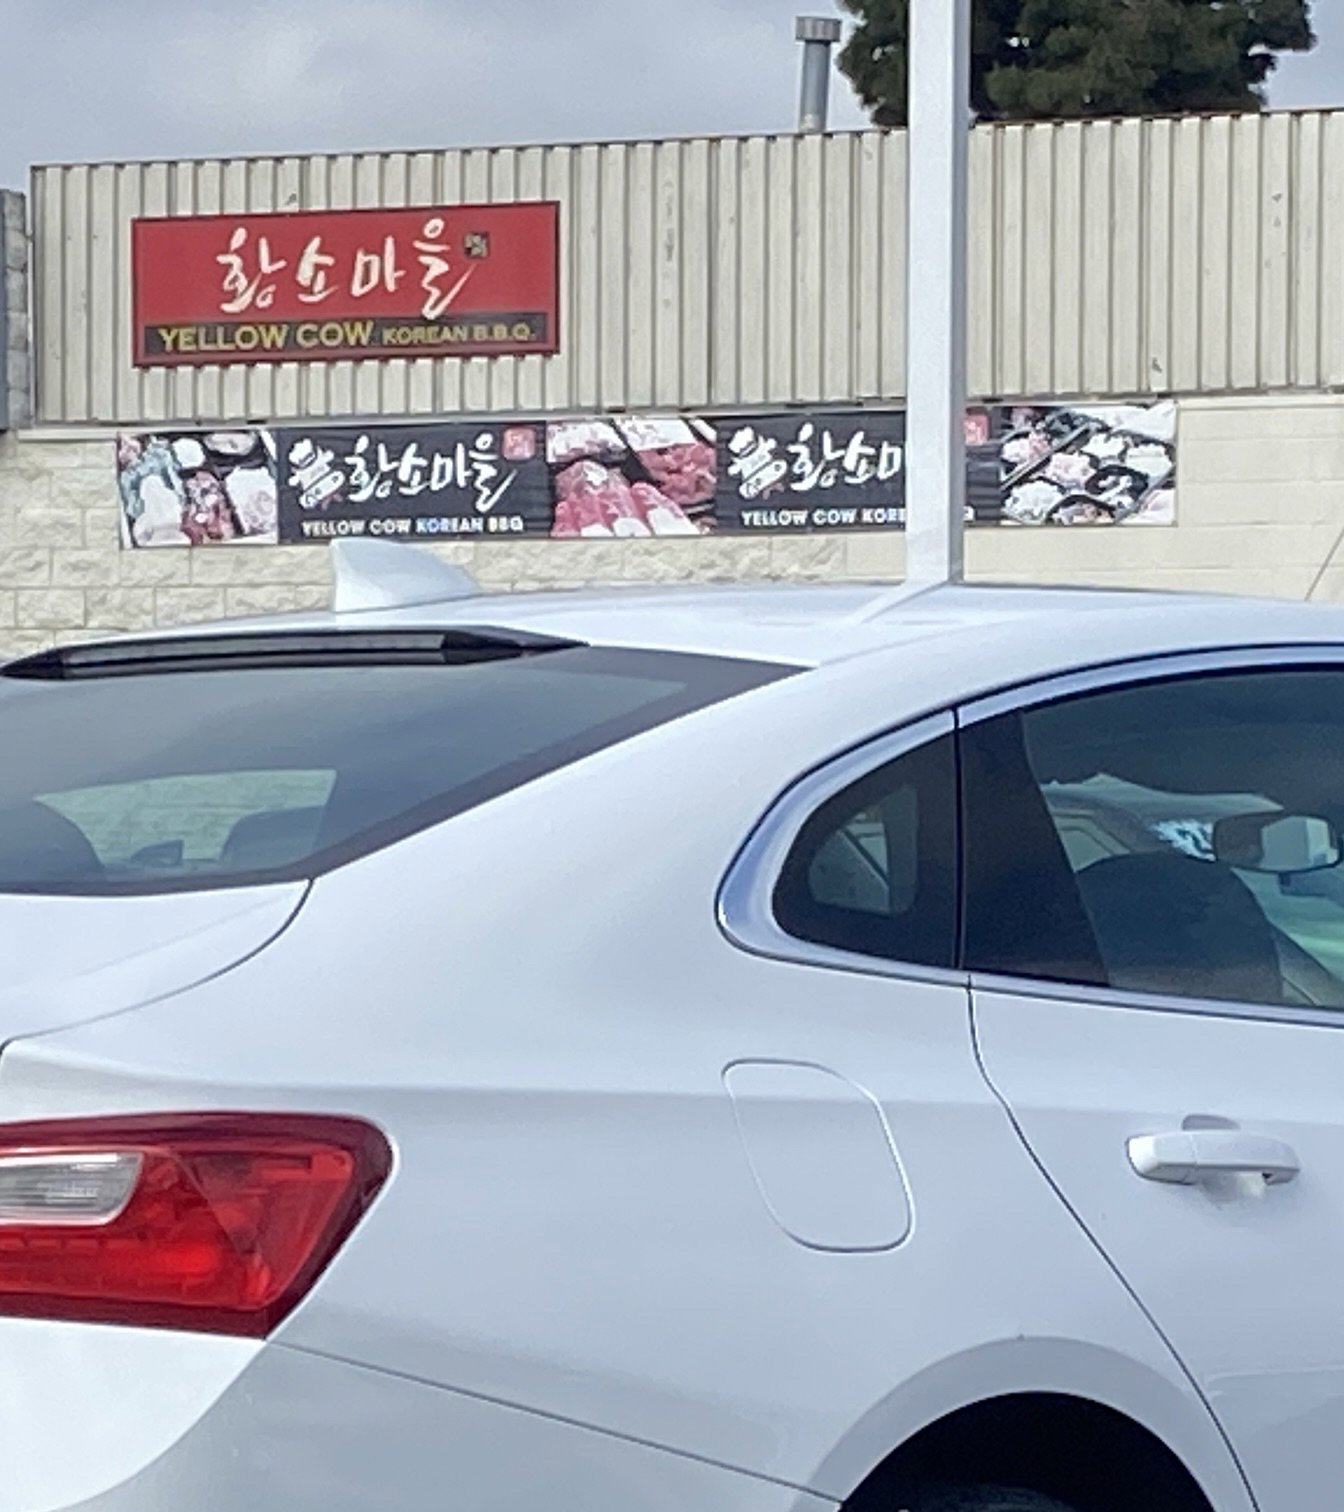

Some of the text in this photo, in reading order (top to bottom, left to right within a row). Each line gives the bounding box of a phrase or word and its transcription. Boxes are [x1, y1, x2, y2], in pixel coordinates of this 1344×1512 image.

[158, 324, 289, 351] YELLOW
[296, 321, 374, 348] COW
[382, 325, 468, 345] KOREAN
[741, 508, 907, 526] YELLOW COW KORE
[301, 520, 365, 535] YELLOW
[369, 519, 412, 535] COW
[416, 518, 484, 533] KOREAN
